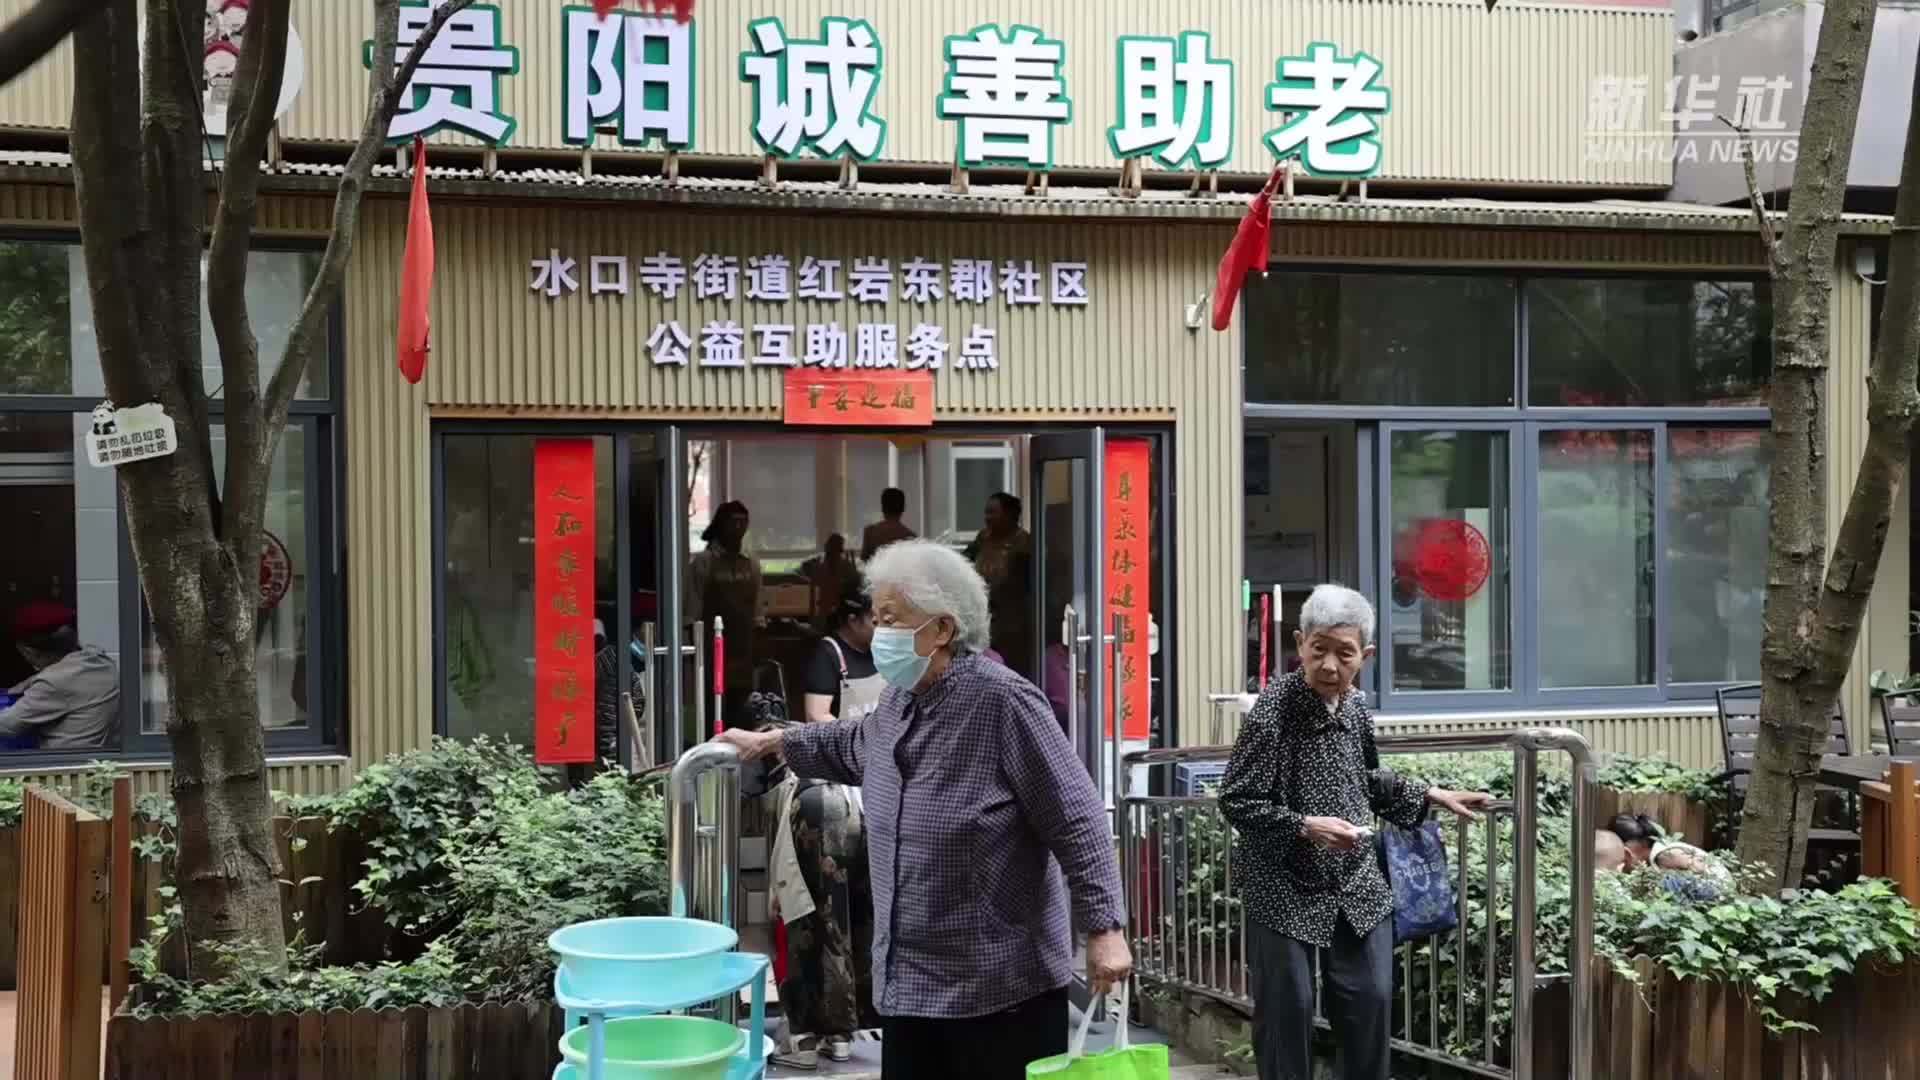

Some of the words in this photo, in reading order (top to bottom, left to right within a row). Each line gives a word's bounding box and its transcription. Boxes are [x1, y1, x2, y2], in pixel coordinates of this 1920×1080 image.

[366, 2, 1390, 177] 贵阳诚善助老
[531, 248, 1089, 306] 水口寺街道红岩东郡社区
[646, 320, 999, 370] 公益互助服务点
